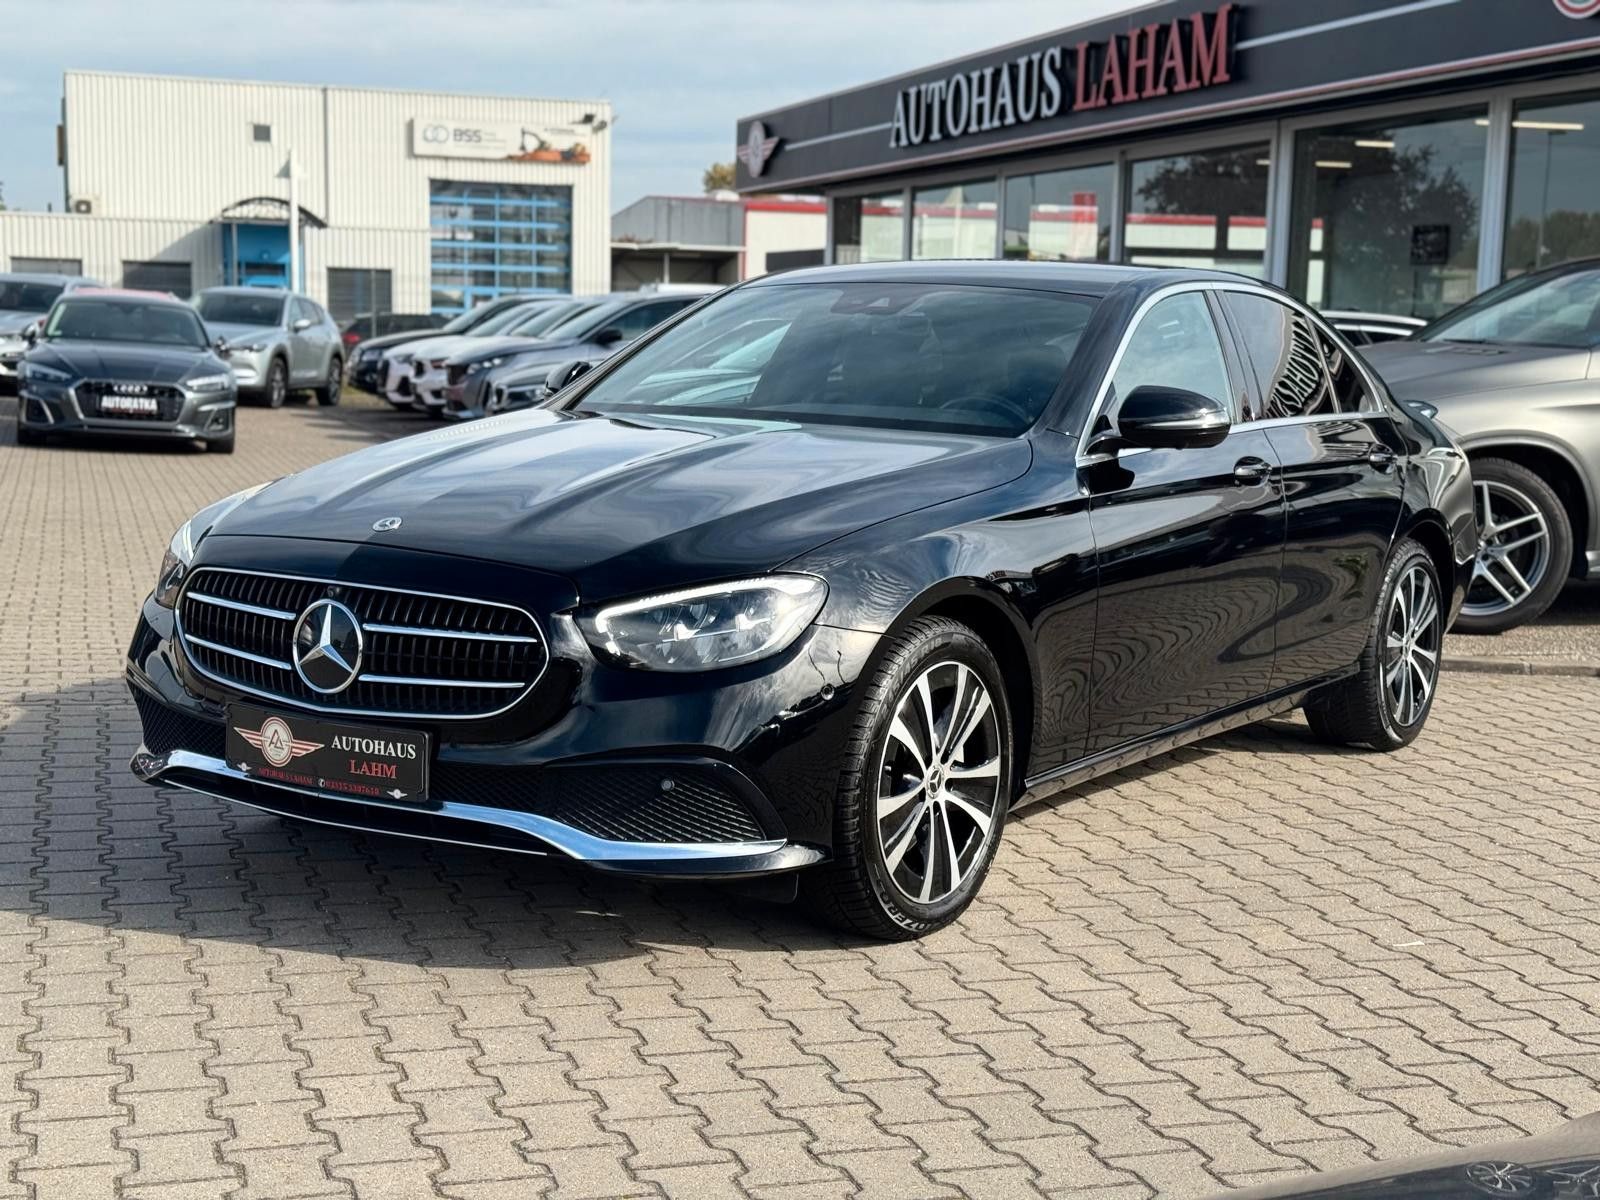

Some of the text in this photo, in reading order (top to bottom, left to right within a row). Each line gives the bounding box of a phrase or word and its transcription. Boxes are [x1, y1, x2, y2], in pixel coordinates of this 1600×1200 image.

[889, 4, 1235, 149] AUTOHAUS LAHAM
[453, 128, 482, 143] BSS
[331, 735, 416, 760] AUTOHAUS
[350, 759, 398, 780] LAHM
